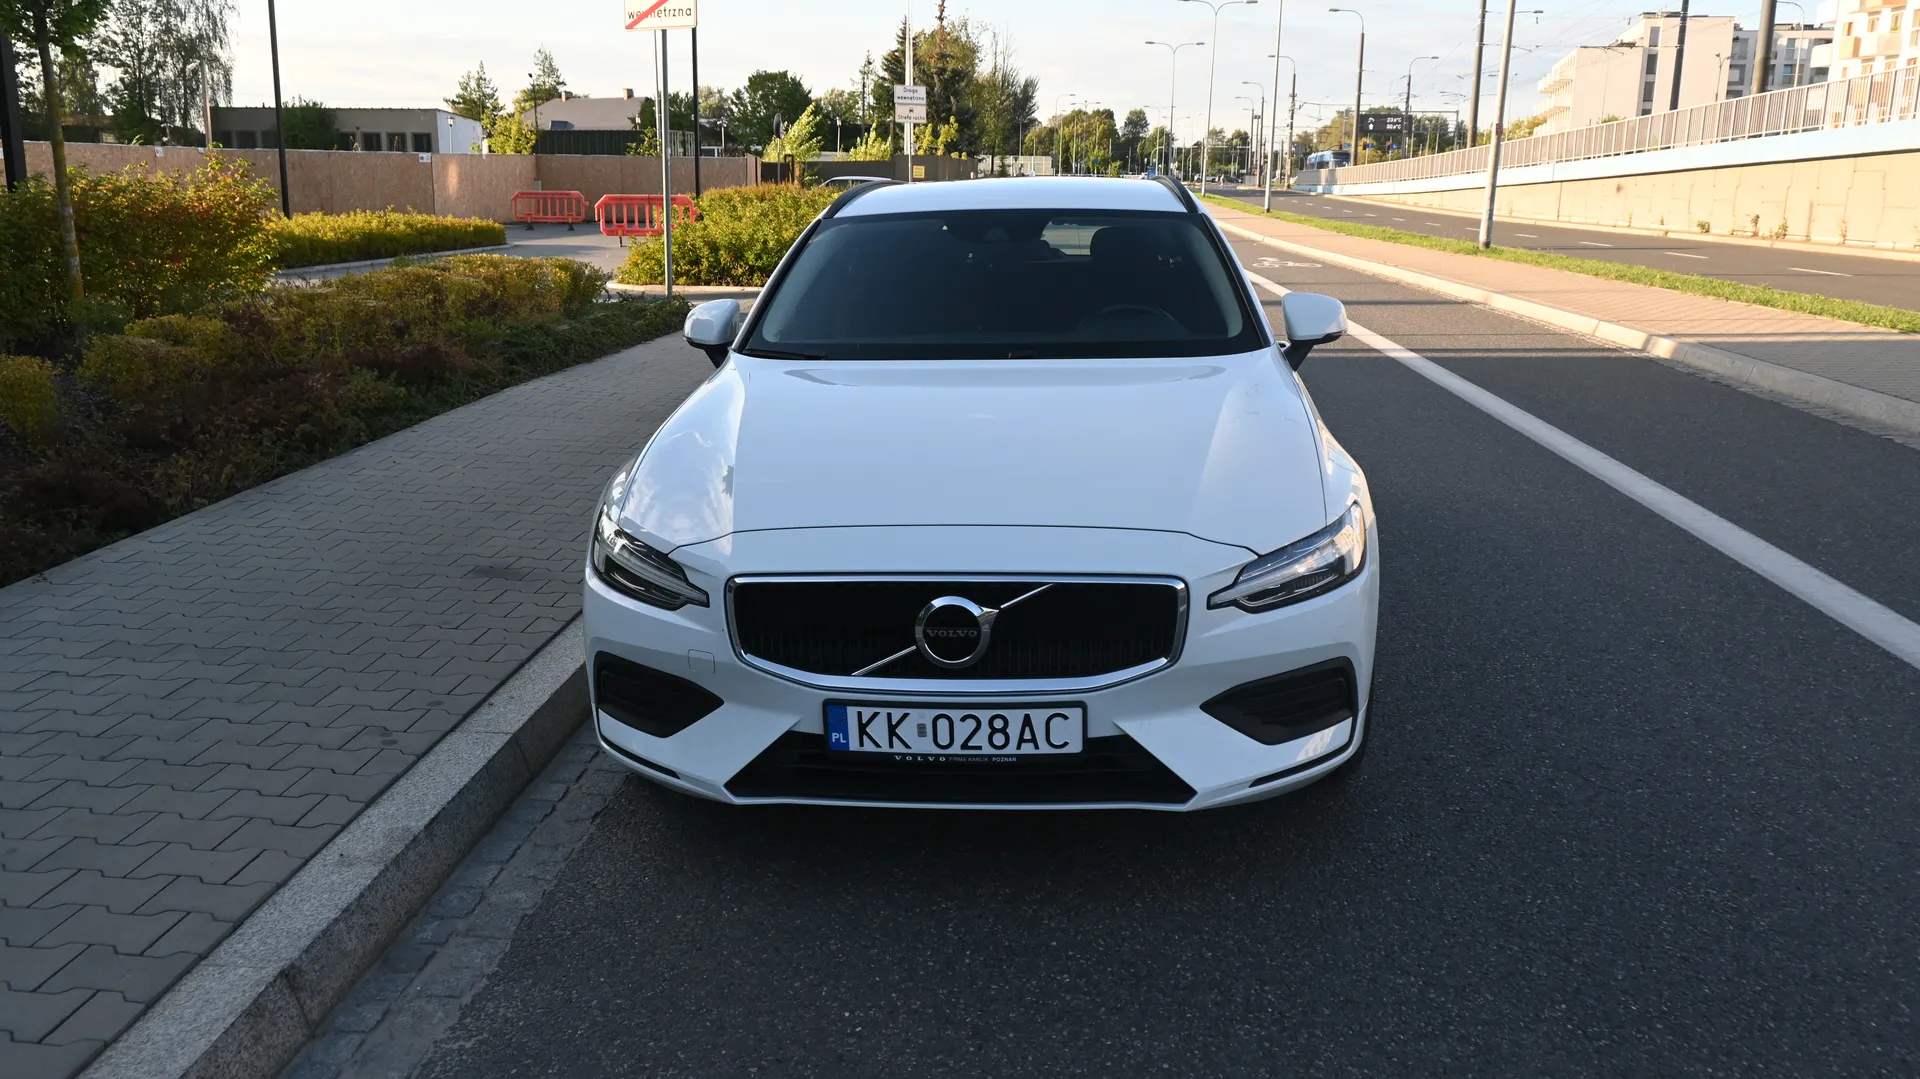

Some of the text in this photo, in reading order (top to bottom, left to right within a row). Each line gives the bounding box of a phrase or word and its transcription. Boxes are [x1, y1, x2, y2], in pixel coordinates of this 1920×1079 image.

[926, 629, 978, 638] VOLVO
[856, 710, 1071, 751] KK 028AC
[831, 732, 847, 744] PL
